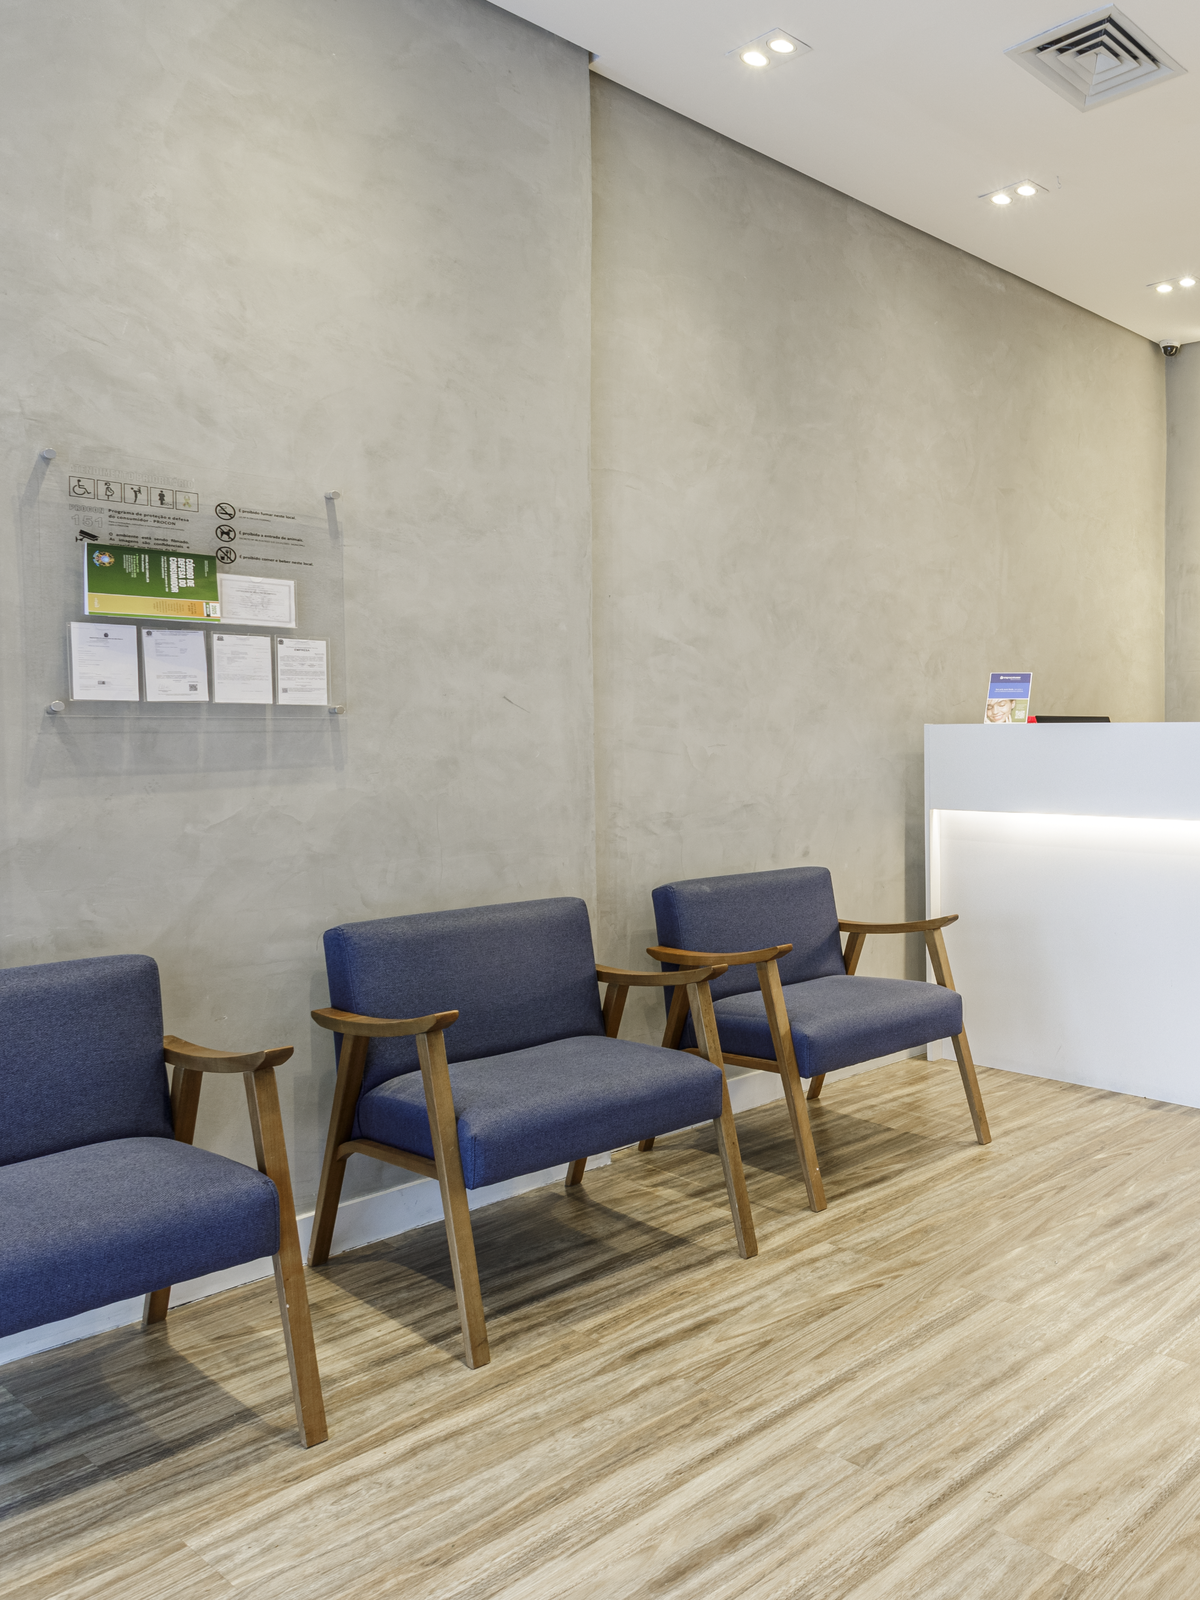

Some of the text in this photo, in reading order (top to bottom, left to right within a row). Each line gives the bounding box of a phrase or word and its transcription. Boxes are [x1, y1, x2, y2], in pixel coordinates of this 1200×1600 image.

[69, 464, 194, 489] ATENDIMENTO PRIORITÁRIO
[68, 504, 104, 514] PROCON
[71, 514, 102, 528] 151
[169, 557, 178, 593] CONSUMIDOR
[178, 558, 187, 588] DEFESA DO
[186, 558, 195, 587] CÓDIGO DE
